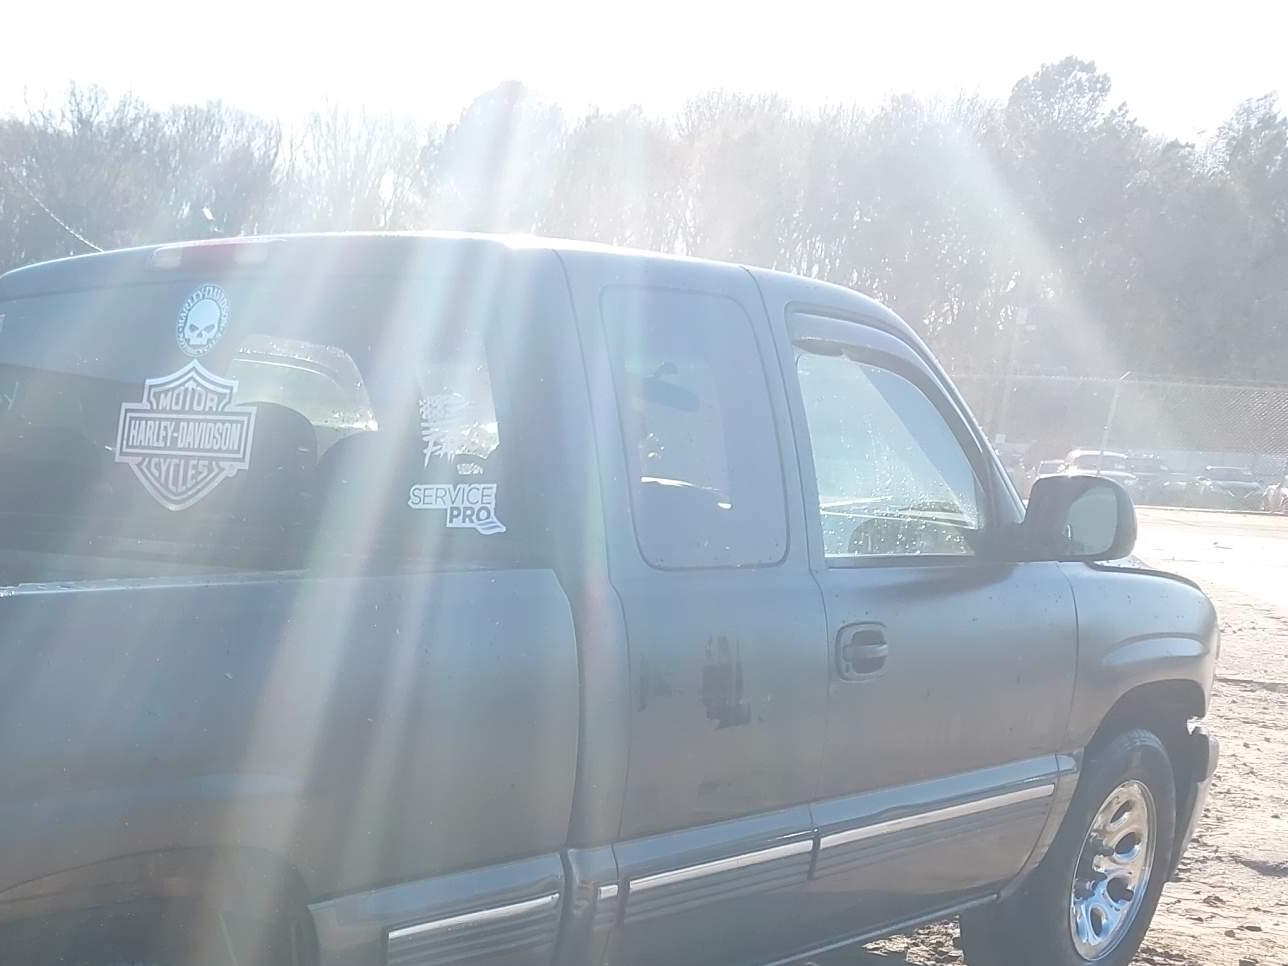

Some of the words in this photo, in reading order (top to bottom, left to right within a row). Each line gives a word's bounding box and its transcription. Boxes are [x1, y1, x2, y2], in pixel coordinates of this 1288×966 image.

[159, 380, 218, 412] MOTOR
[128, 420, 241, 451] HARLEY-DAVIDSON
[150, 458, 210, 493] CYCLES
[411, 486, 493, 505] SERVICE
[448, 506, 491, 524] PRO
